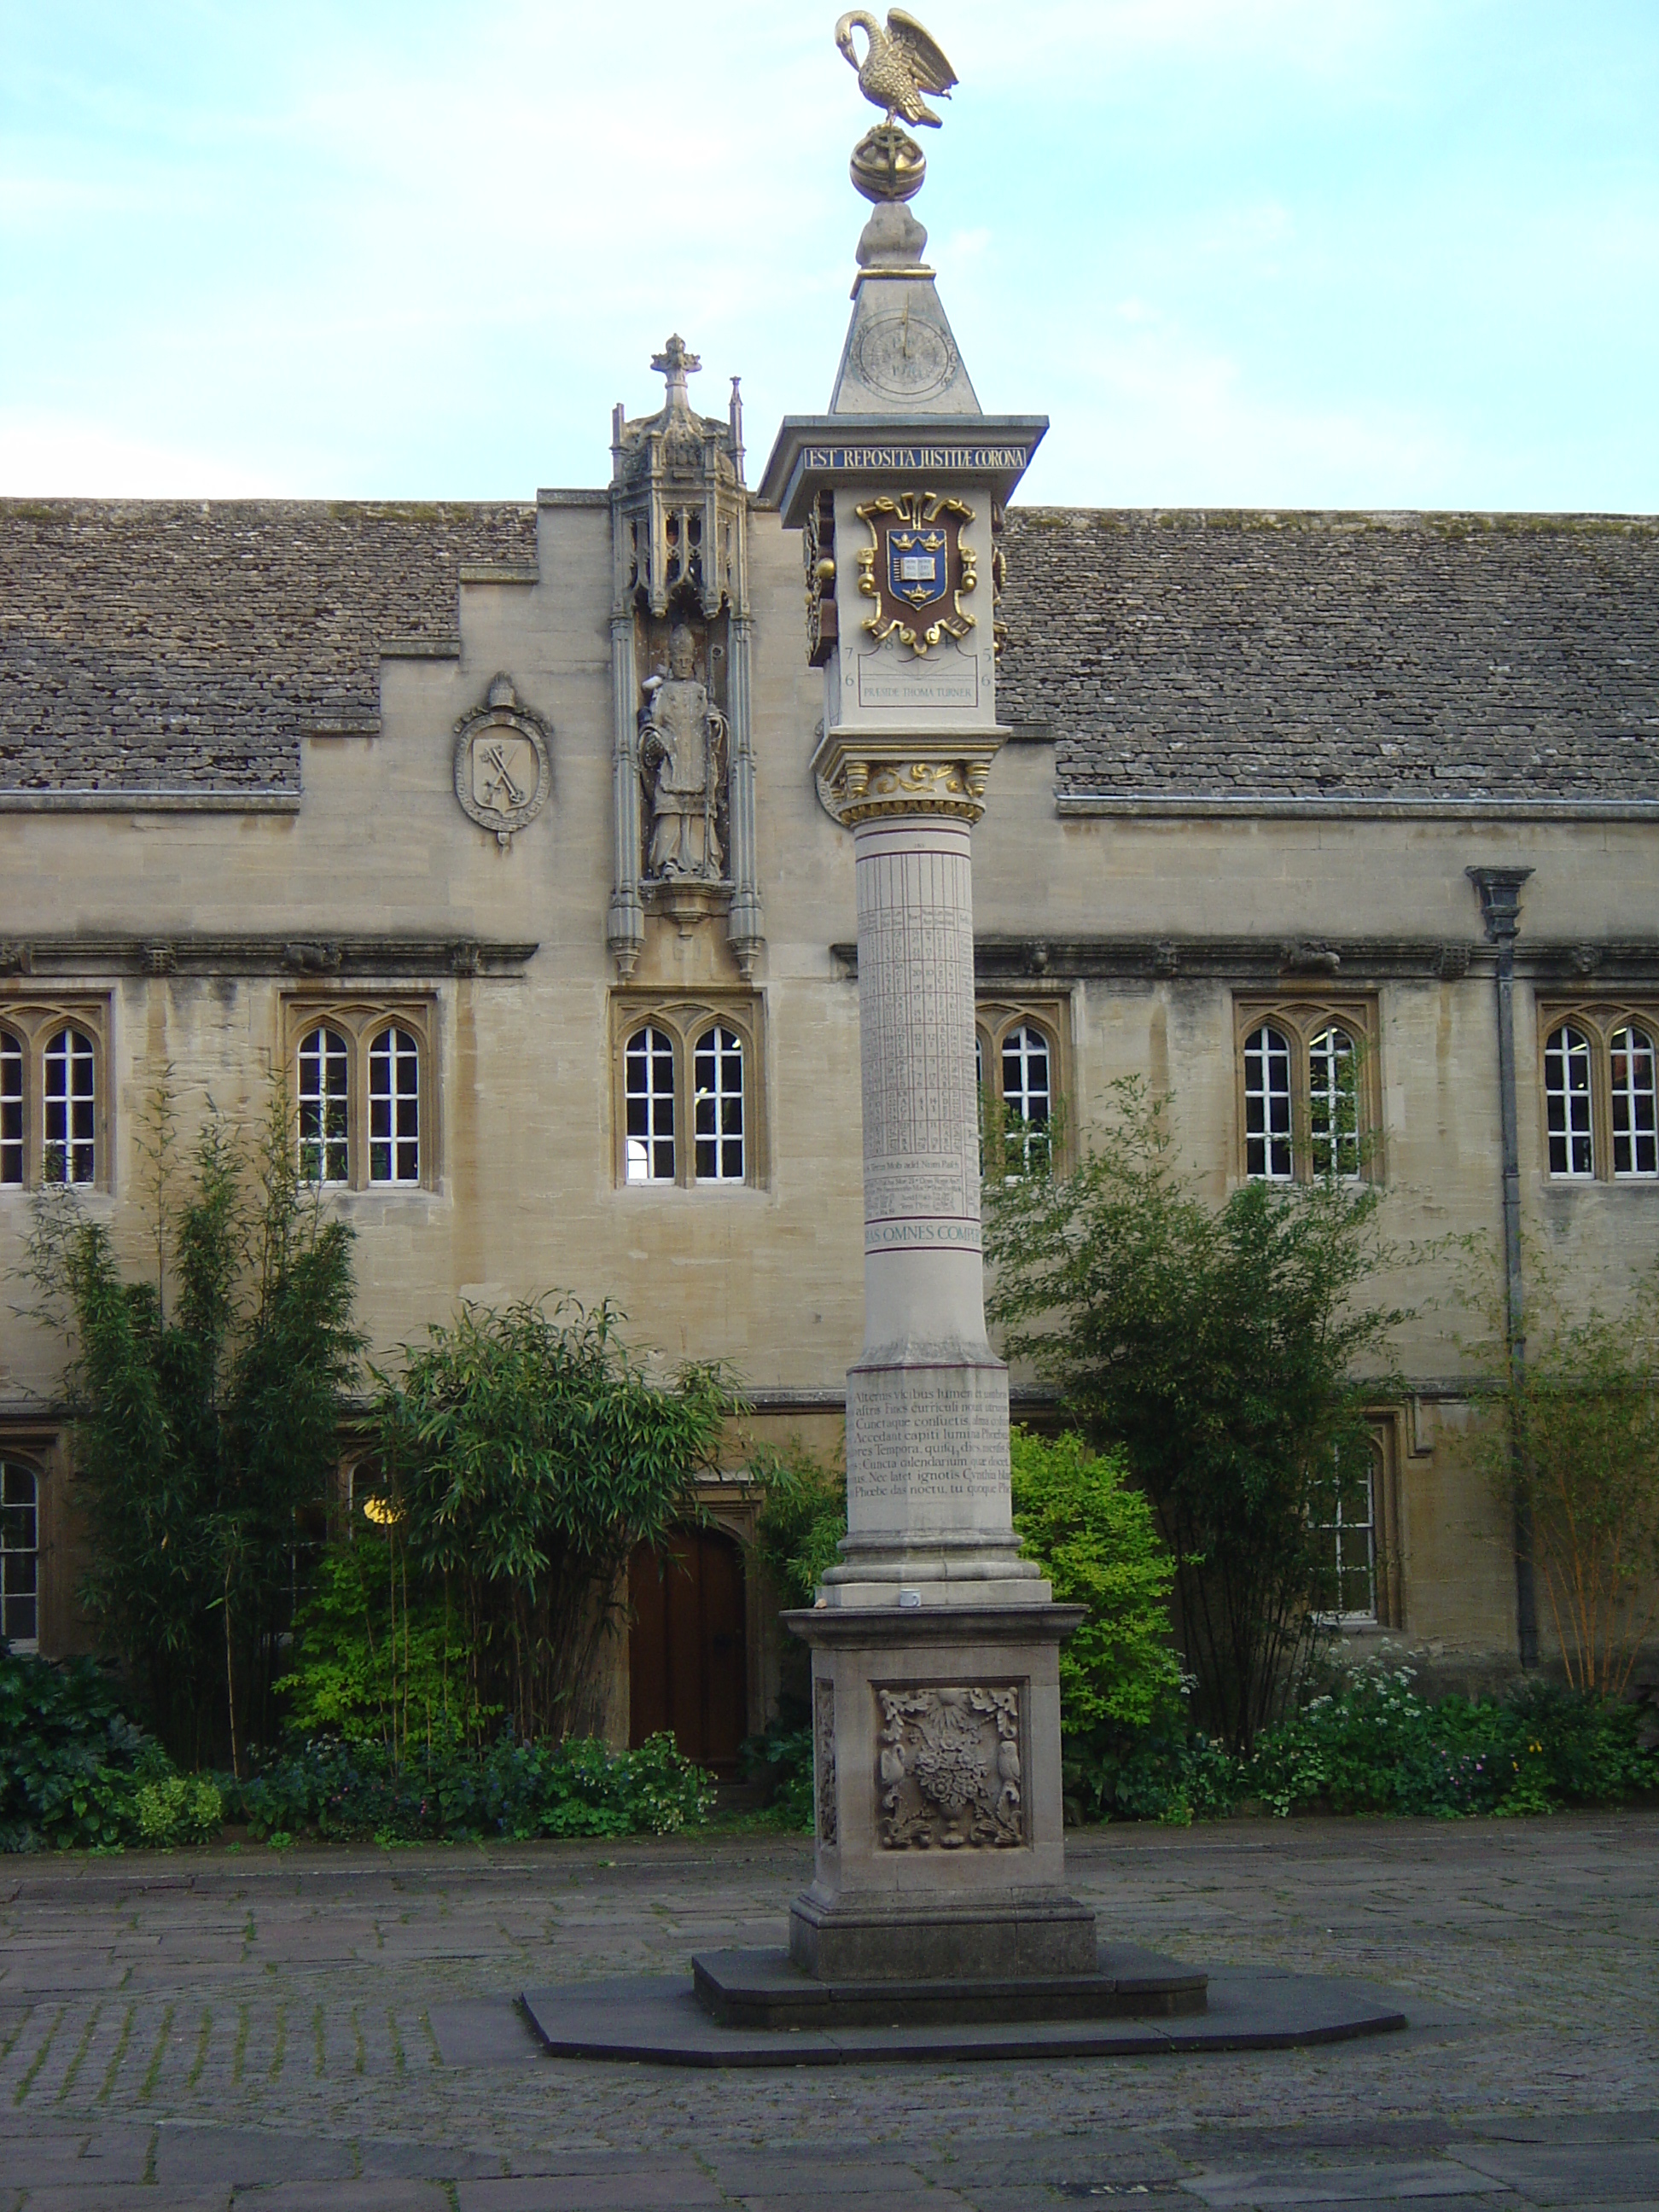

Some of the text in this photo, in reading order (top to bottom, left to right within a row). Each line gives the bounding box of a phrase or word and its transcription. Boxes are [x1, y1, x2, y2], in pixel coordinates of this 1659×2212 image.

[809, 449, 837, 468] EST
[844, 448, 917, 468] REPOSITA
[975, 449, 1024, 468] CORONA
[884, 637, 894, 650] 8
[940, 634, 952, 649] 4
[845, 647, 853, 661] 7
[982, 648, 992, 662] 5
[844, 672, 854, 687] 6
[981, 674, 991, 687] 6
[902, 687, 934, 698] THOMA
[935, 687, 973, 698] TURNER
[883, 1225, 934, 1243] OMNES
[936, 1388, 974, 1400] lumen
[855, 1417, 911, 1430] Cunctaque
[853, 1430, 903, 1444] Accedant
[904, 1429, 940, 1442] capiti
[943, 1428, 981, 1440] lumina
[862, 1457, 897, 1470] Cuncta
[899, 1455, 968, 1468] calendarium
[917, 1470, 961, 1485] ignotis
[890, 1484, 907, 1496] das
[950, 1484, 963, 1494] tu
